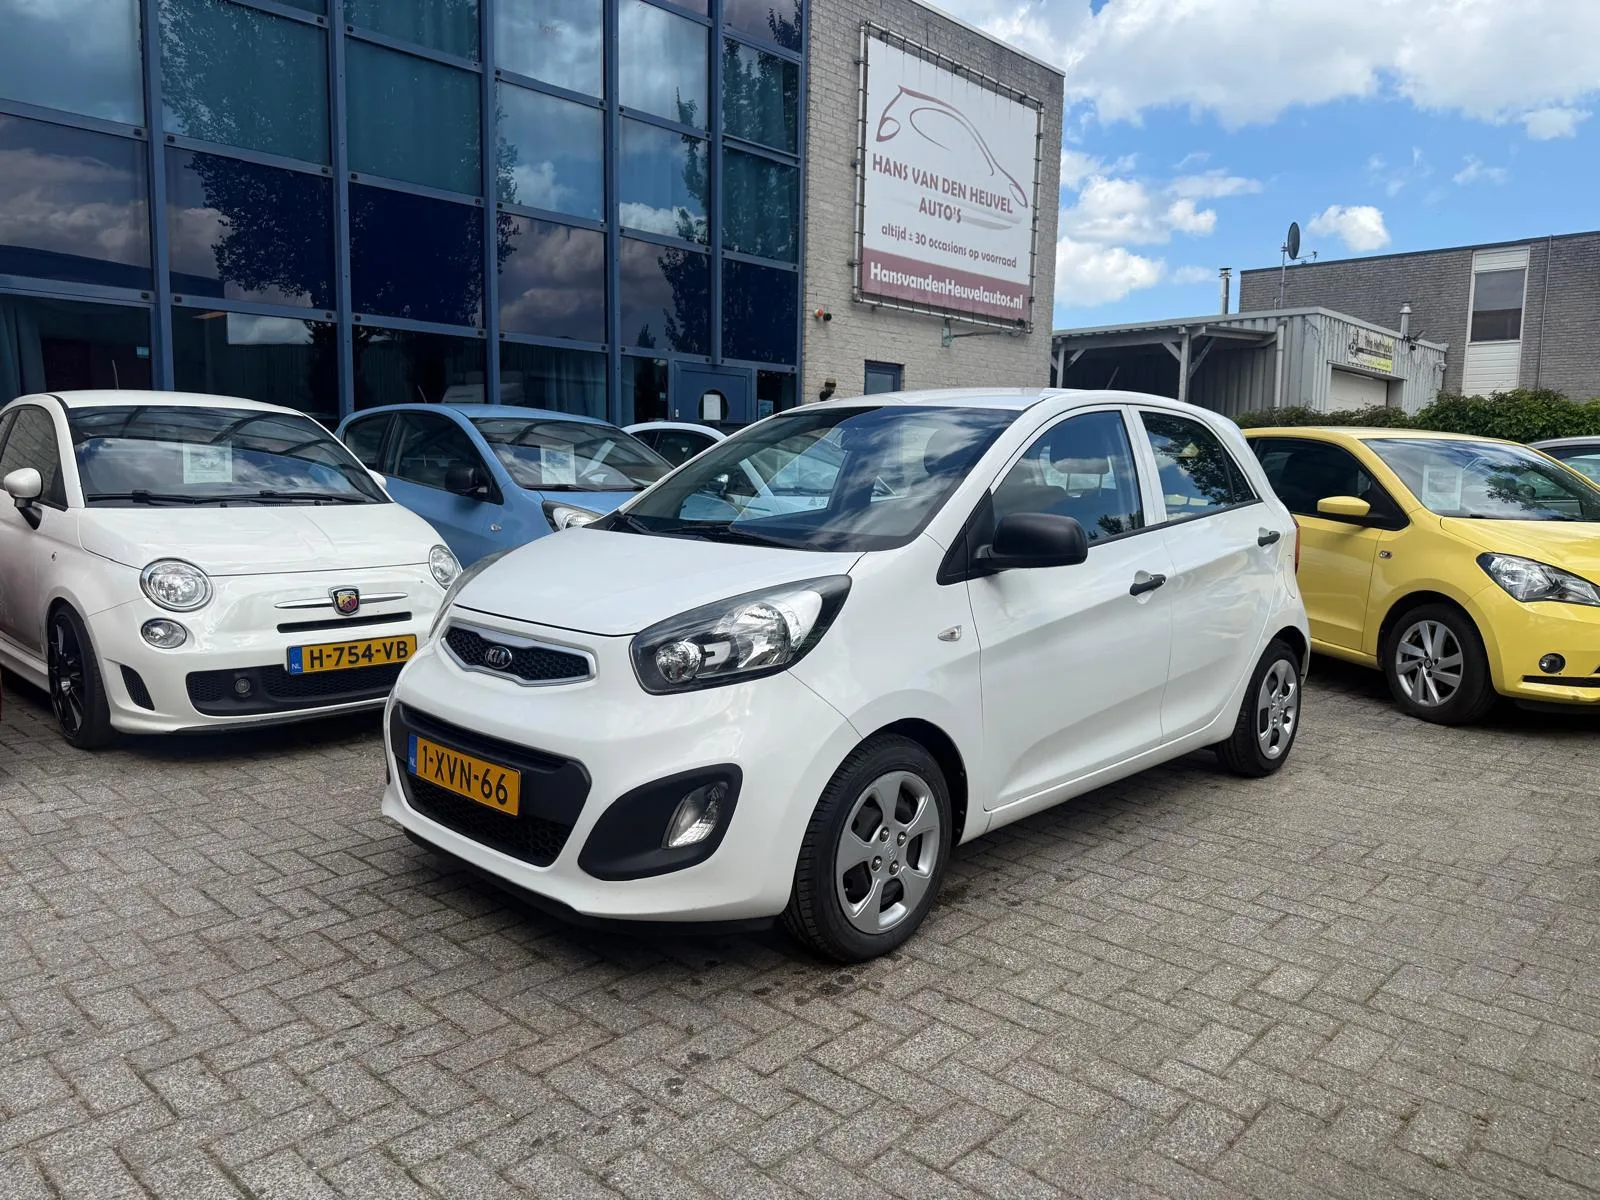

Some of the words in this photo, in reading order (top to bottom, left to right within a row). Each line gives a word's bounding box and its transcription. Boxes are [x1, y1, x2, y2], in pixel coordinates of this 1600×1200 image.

[873, 153, 908, 181] HANS
[912, 167, 939, 191] VAN
[942, 177, 967, 200] DEN
[970, 186, 1013, 214] HEUVEL
[919, 196, 961, 224] AUTO'S
[881, 223, 906, 240] altijd
[915, 232, 926, 246] 30
[929, 238, 967, 256] occasions
[969, 249, 979, 260] op
[981, 252, 1017, 268] voorraad
[870, 261, 1023, 310] HansvandenHeuvelautos.nl
[309, 641, 408, 669] H-754-VB
[487, 648, 506, 665] KIA
[422, 745, 508, 805] 1-XVN-66
